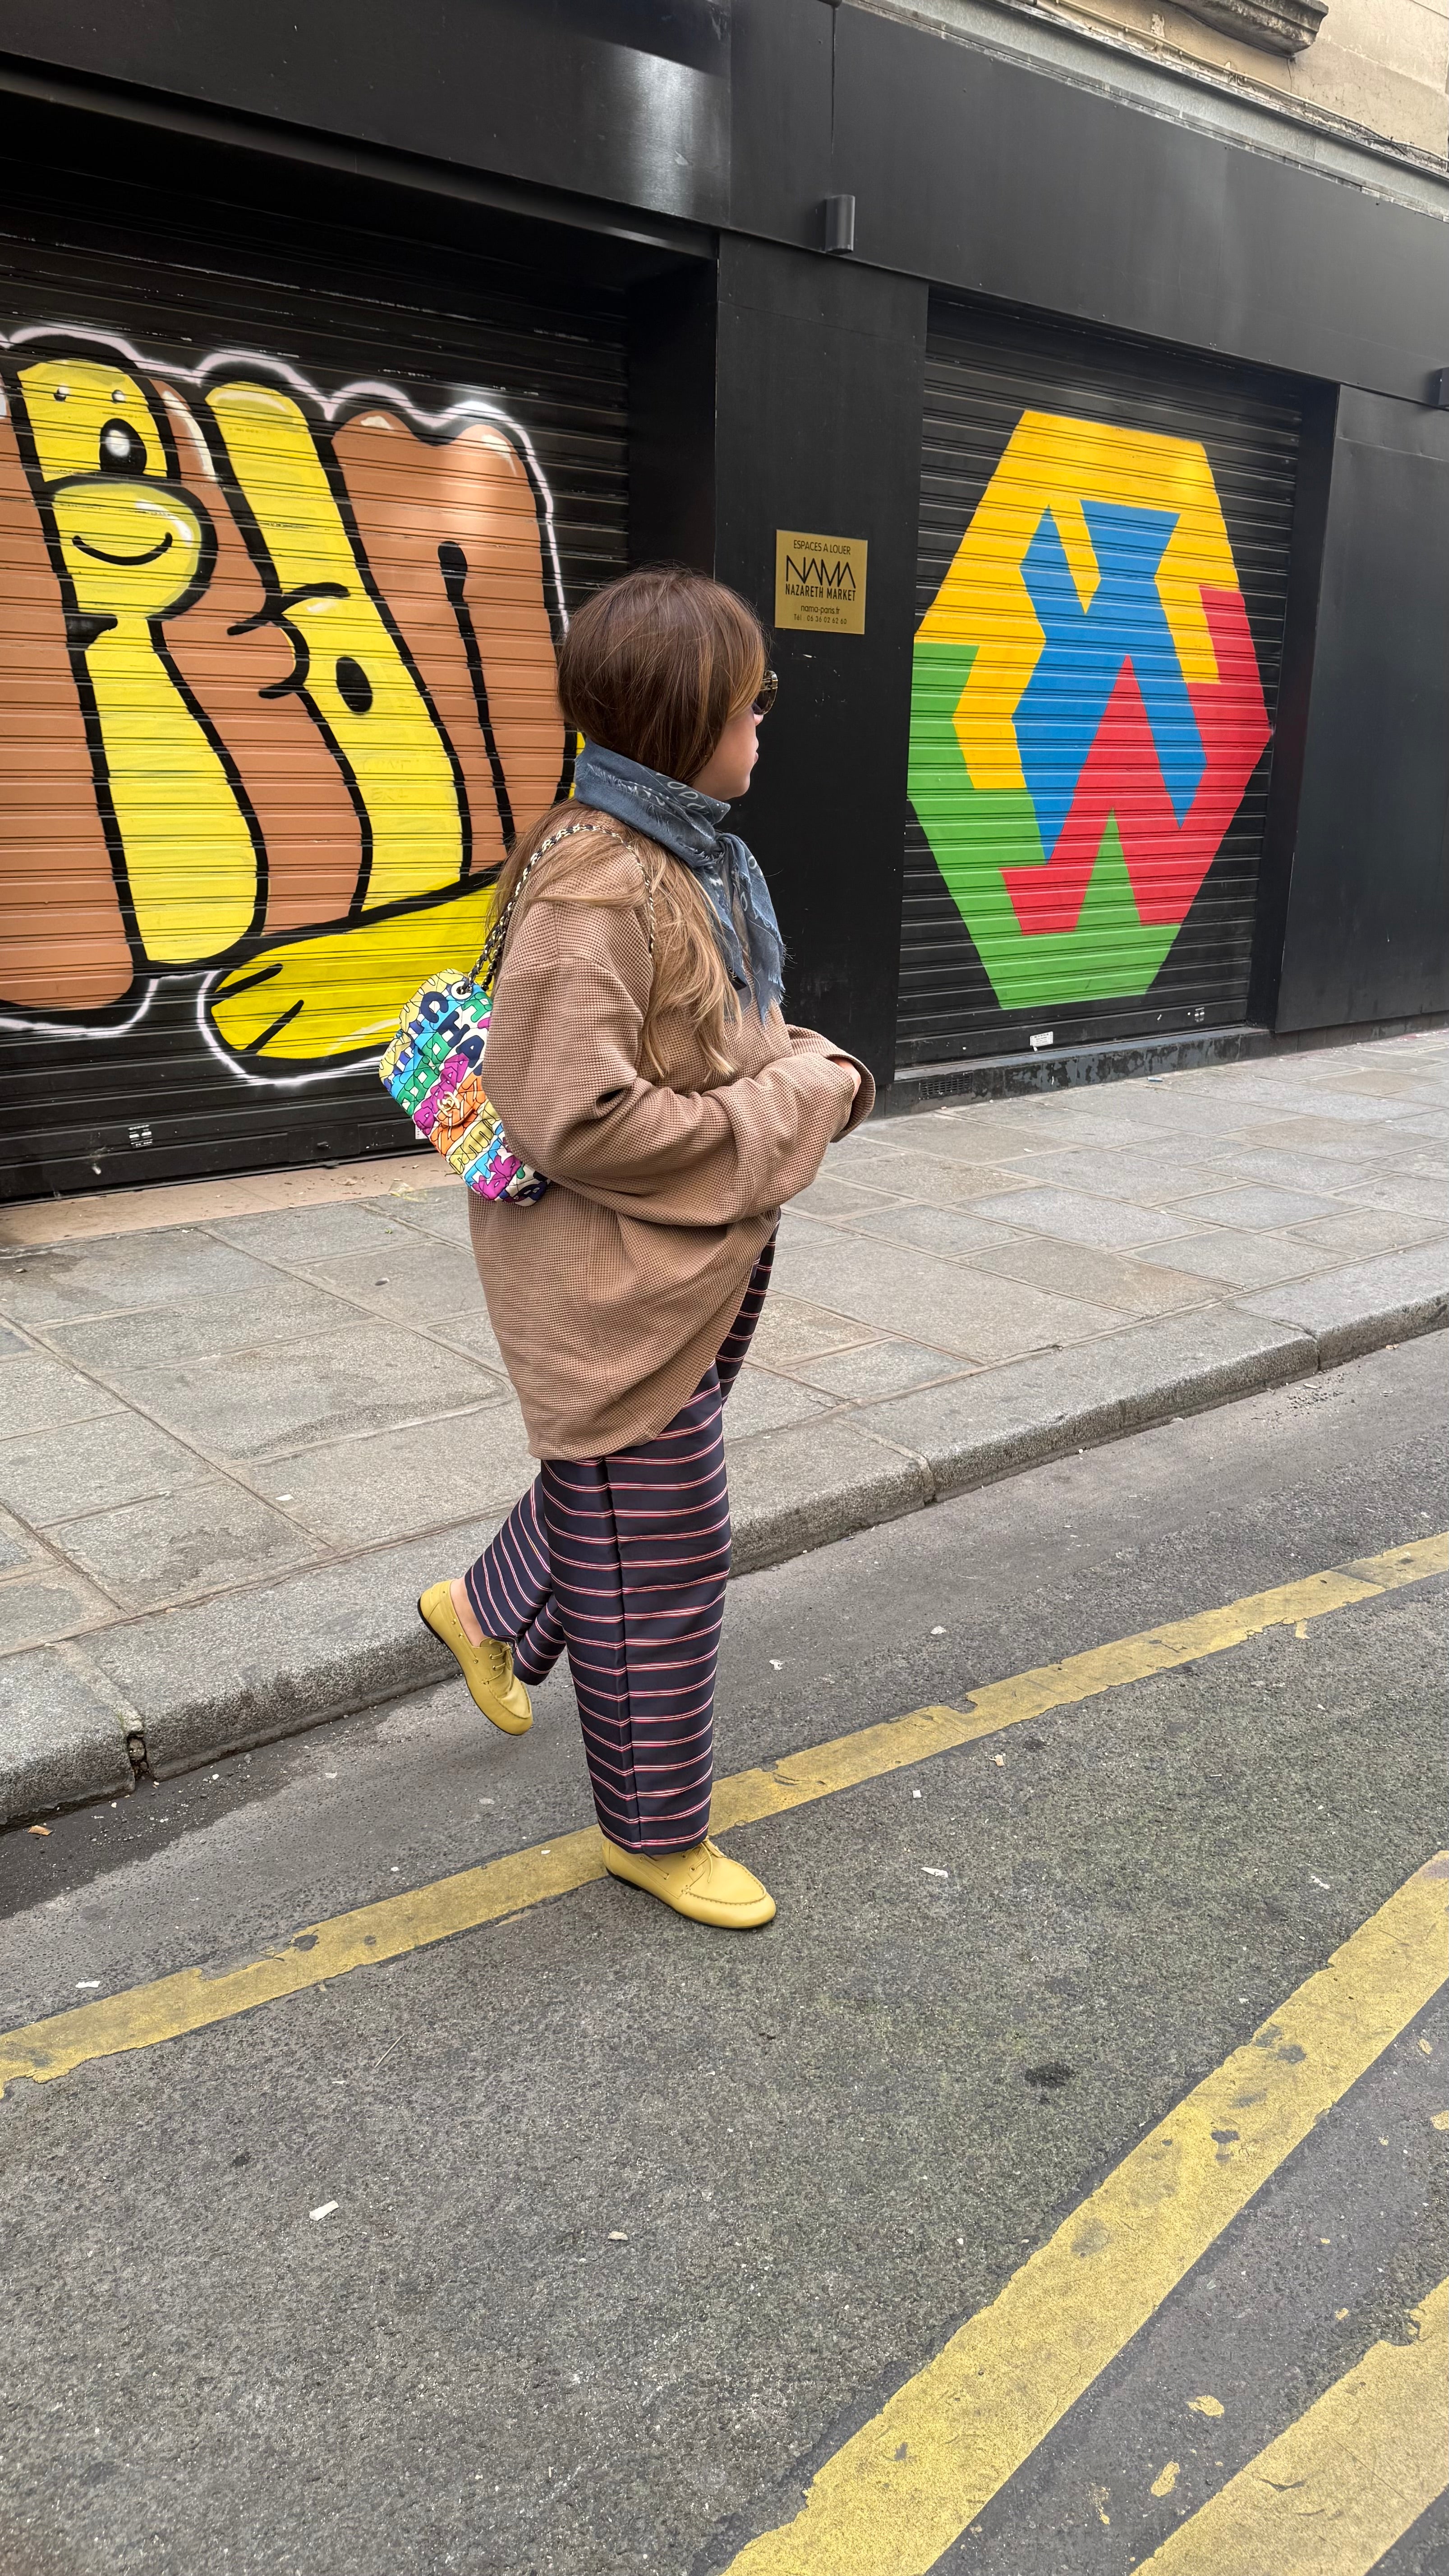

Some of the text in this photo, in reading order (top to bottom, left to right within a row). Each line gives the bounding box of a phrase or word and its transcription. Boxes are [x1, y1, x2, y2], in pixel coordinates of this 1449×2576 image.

[793, 539, 851, 555] ESPACES A LOUER
[786, 555, 856, 589] NAMA
[785, 583, 856, 601] NAZARETH MARKET
[800, 605, 840, 615] nama-paris.fr
